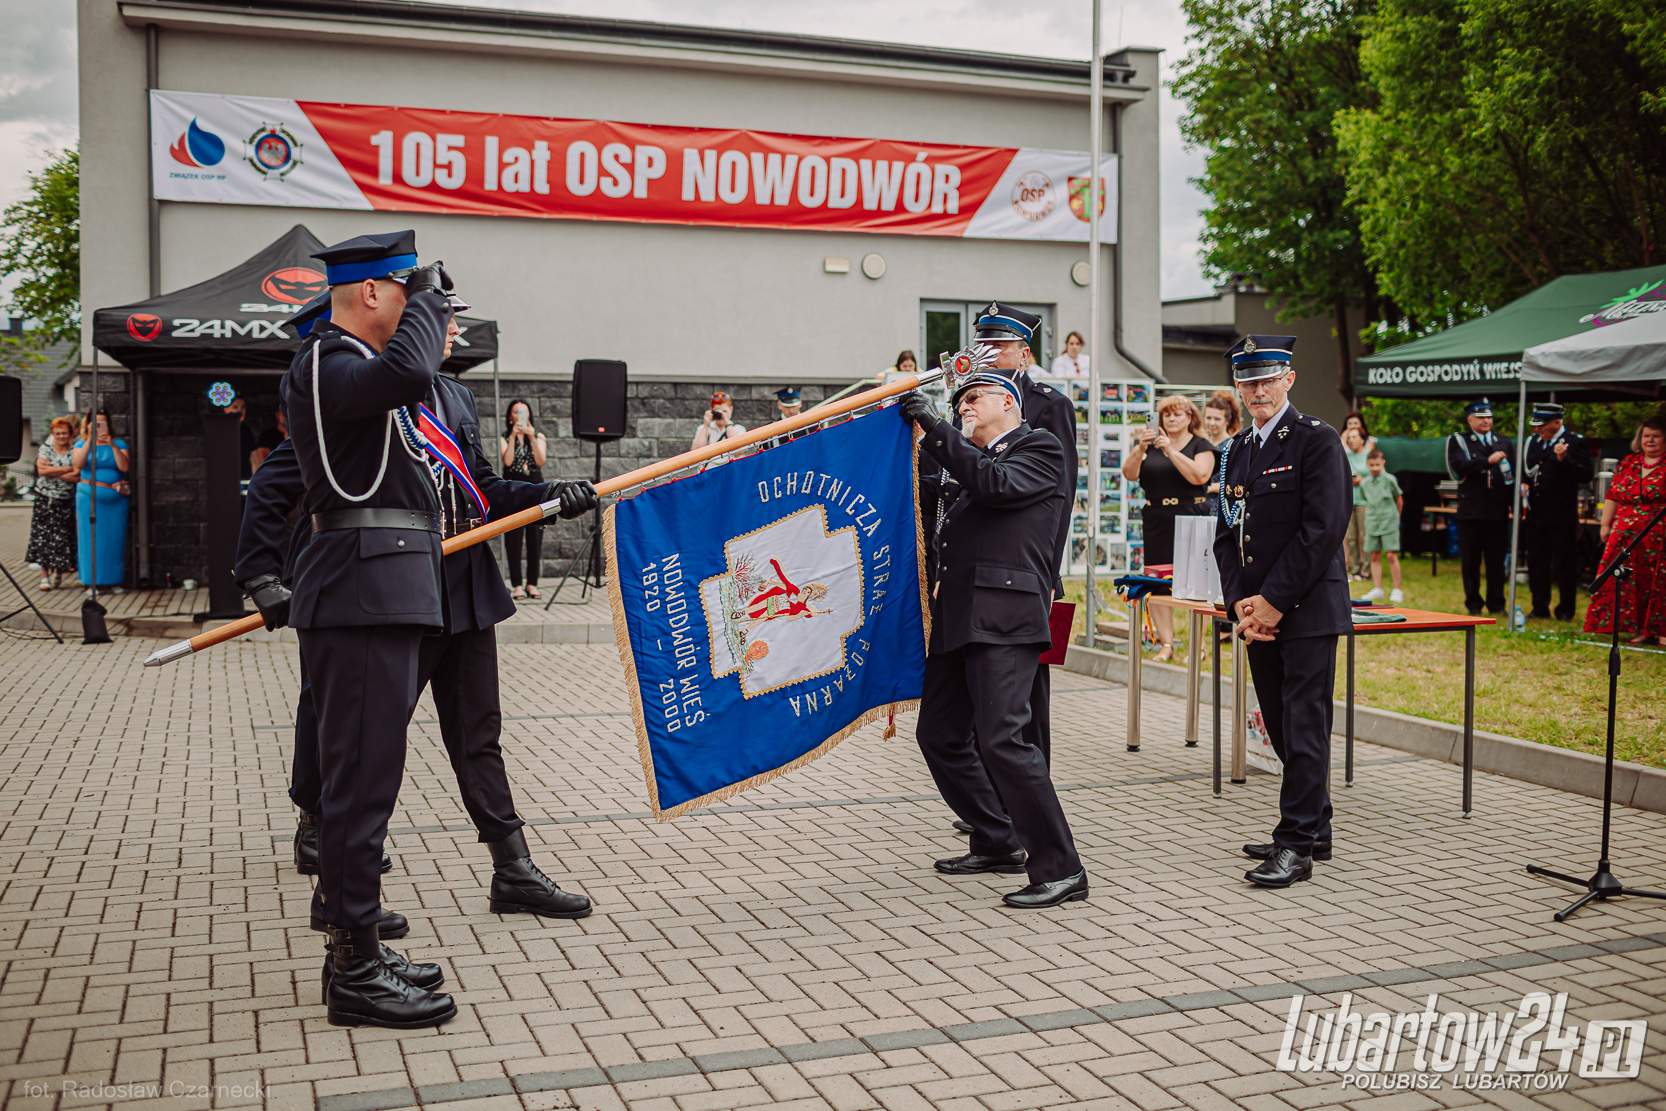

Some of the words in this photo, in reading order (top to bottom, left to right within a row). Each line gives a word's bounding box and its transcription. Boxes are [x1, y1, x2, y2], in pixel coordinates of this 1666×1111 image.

[369, 130, 467, 190] 105
[484, 136, 551, 195] lat
[565, 140, 668, 199] OSP
[681, 147, 962, 215] NOWODWÓR
[1021, 188, 1046, 201] OSP
[171, 318, 291, 339] 24MX
[240, 303, 303, 313] 24
[1368, 367, 1403, 384] KOŁO
[1406, 359, 1480, 383] GOSPODYŃ
[1483, 362, 1523, 380] WIEJS
[757, 470, 883, 538] OCHOTNICZA
[661, 552, 701, 671] NOWODWÓR
[642, 562, 662, 613] 1920
[658, 678, 682, 733] 2000
[678, 673, 712, 728] WIEŚ
